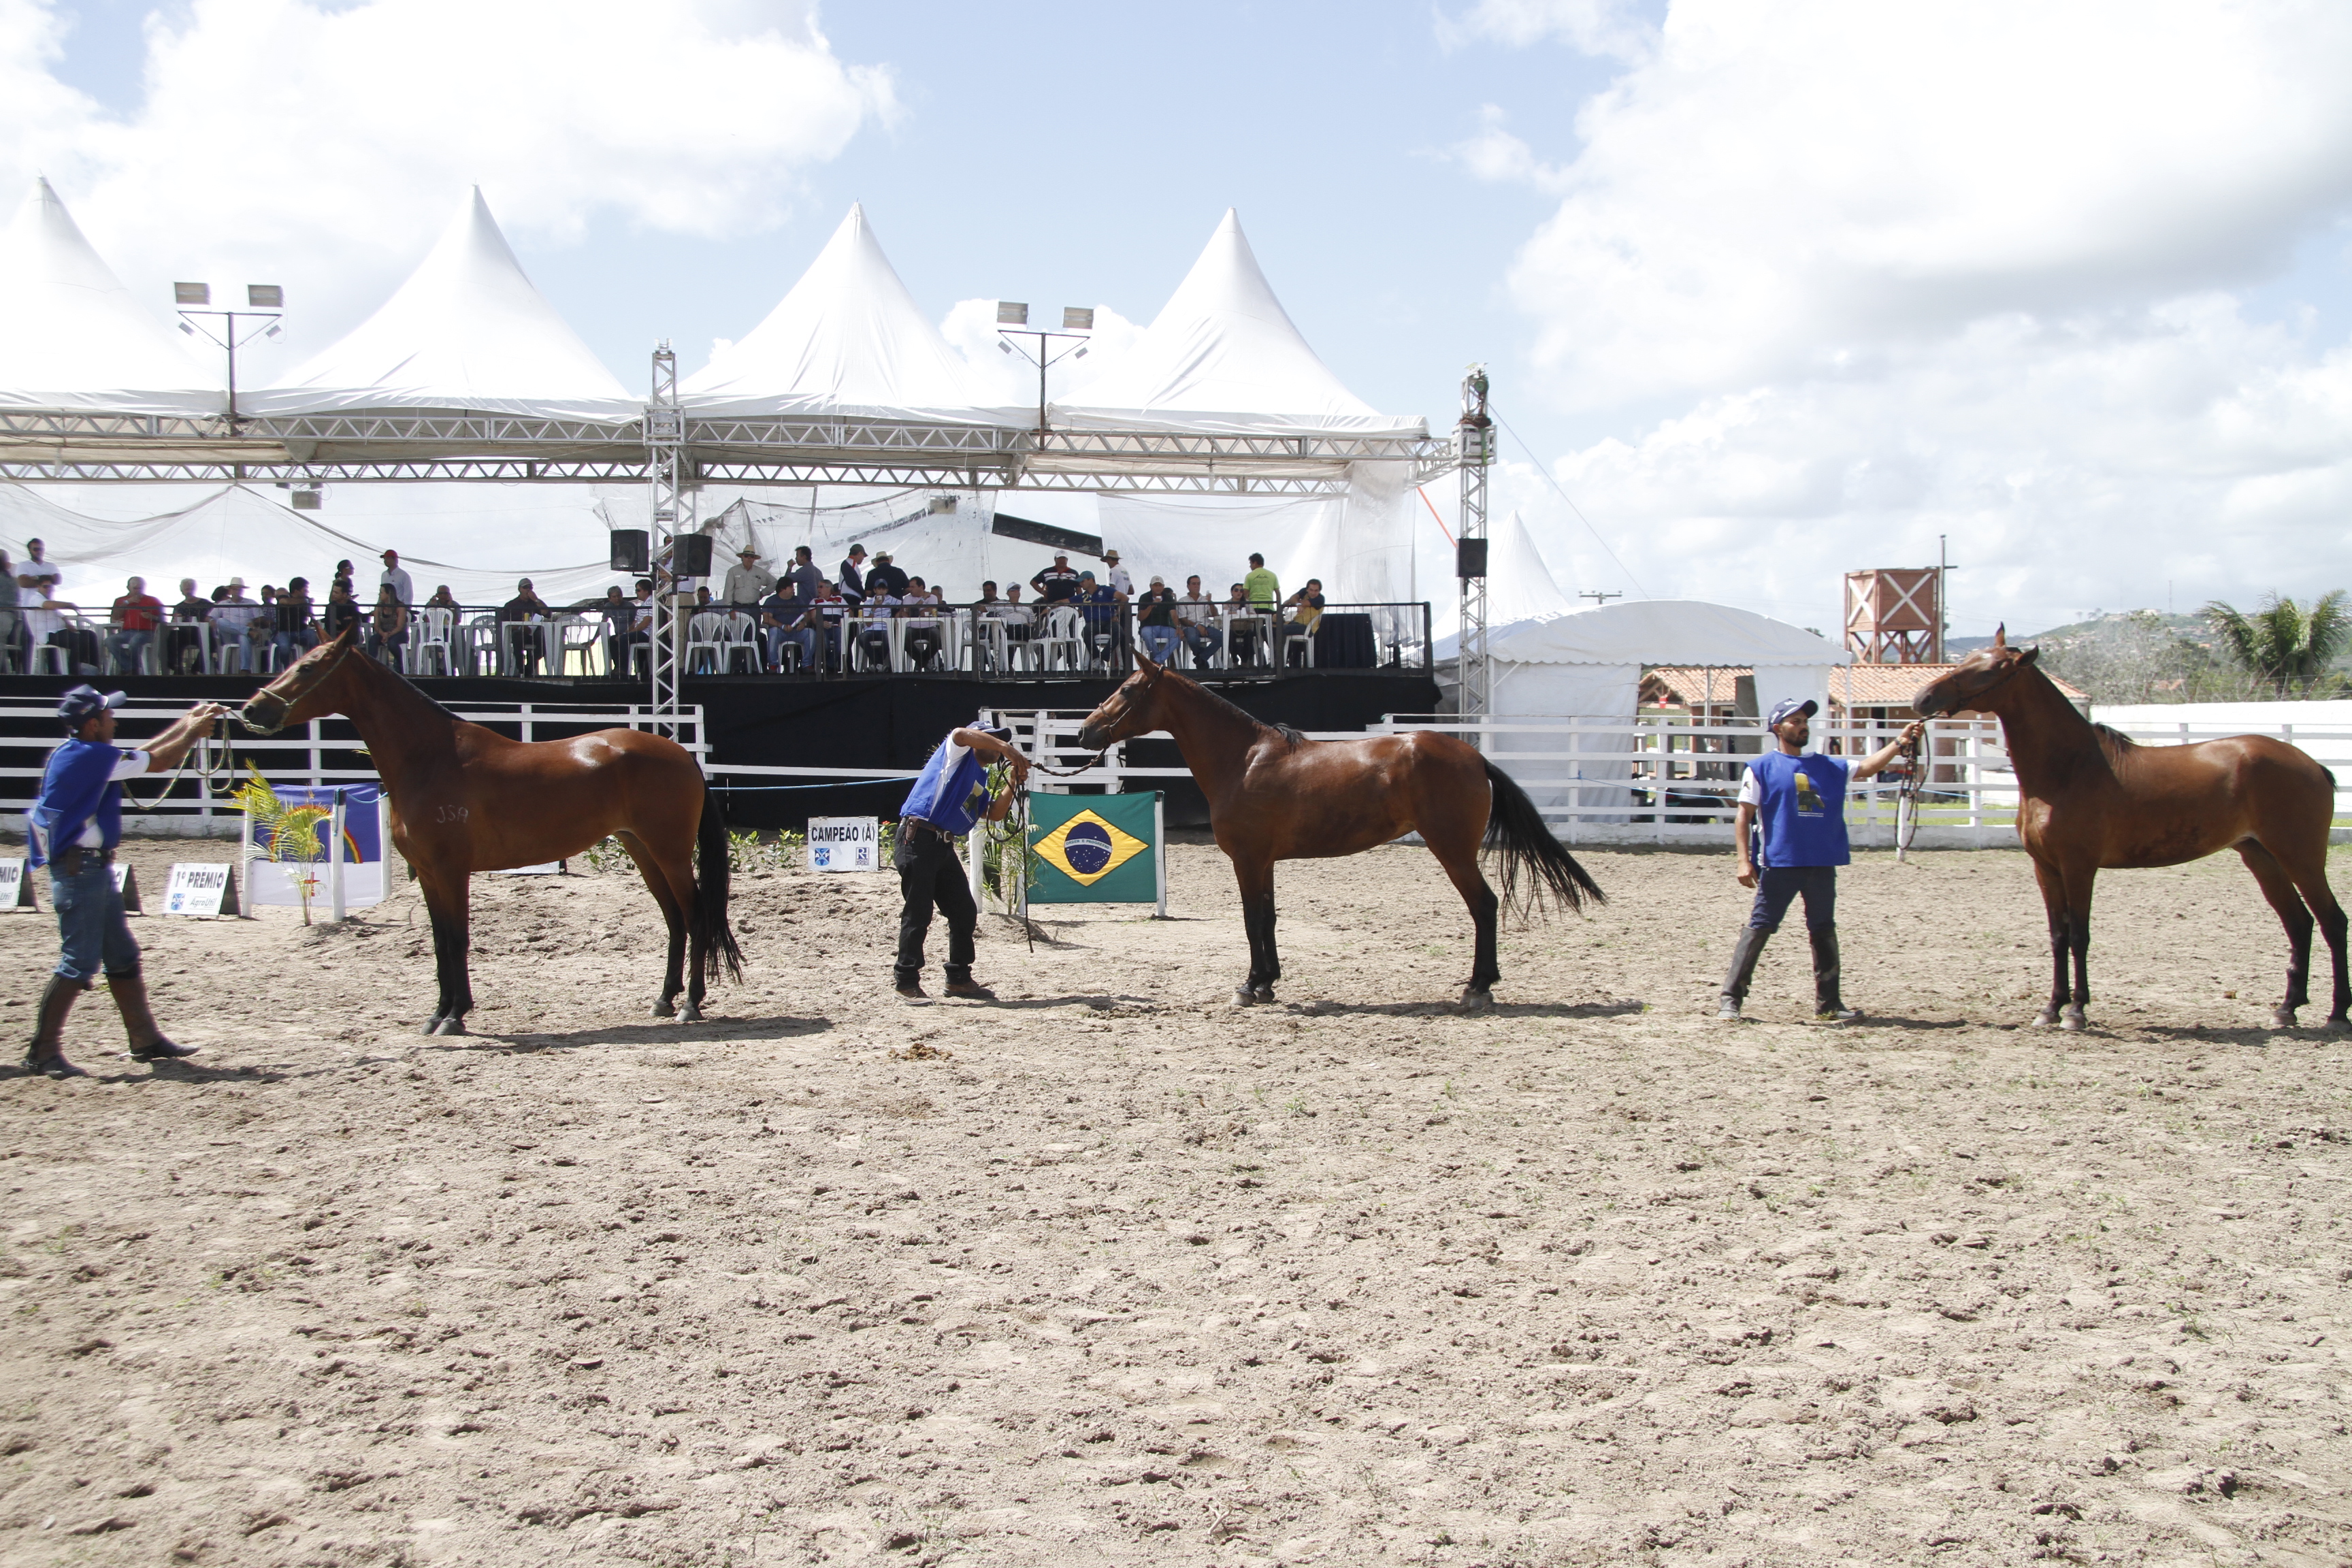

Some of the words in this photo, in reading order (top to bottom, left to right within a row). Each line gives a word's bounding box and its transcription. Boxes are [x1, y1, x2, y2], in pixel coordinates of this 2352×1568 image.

[1081, 593, 1092, 603] 2
[811, 823, 859, 842] CAMPEÃO
[1086, 839, 1109, 849] PROGRESSO
[187, 866, 224, 888] PRÊMIO
